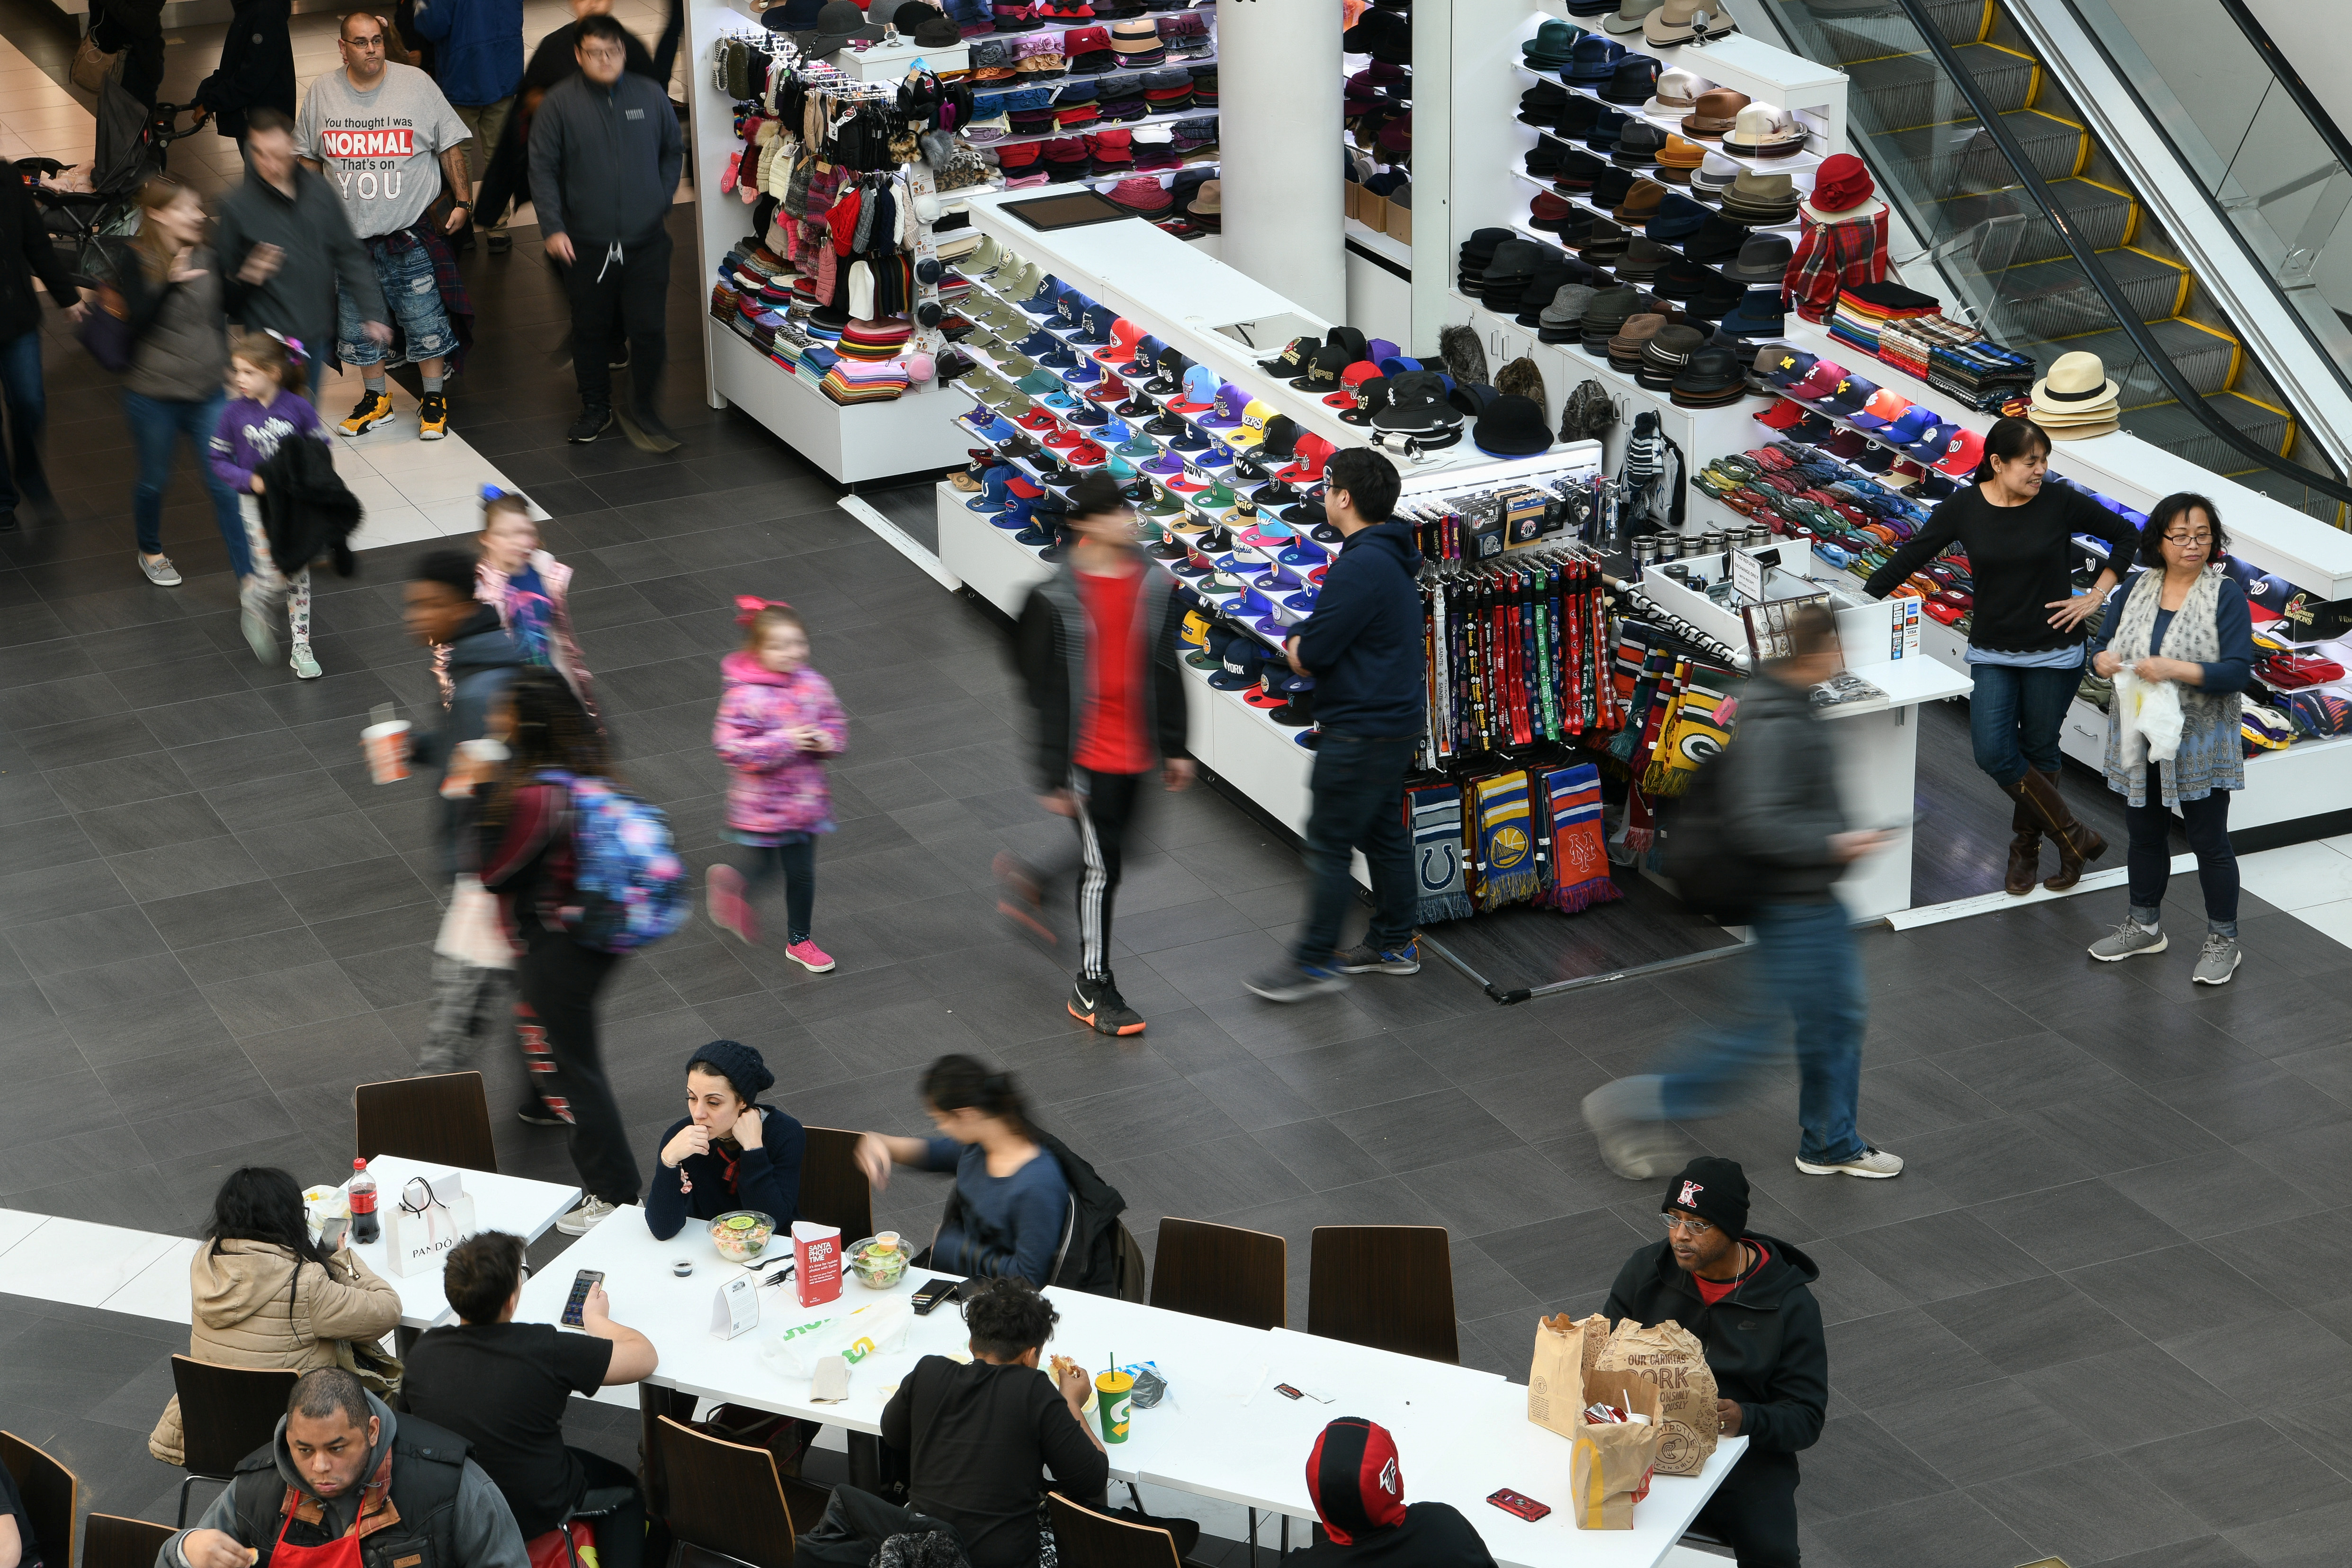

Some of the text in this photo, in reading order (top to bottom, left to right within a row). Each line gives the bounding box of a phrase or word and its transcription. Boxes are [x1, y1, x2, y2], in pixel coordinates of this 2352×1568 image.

[325, 116, 412, 130] You thought I was
[323, 132, 411, 155] NORMAL
[340, 158, 395, 170] That's on
[336, 171, 402, 200] YOU
[1474, 519, 1482, 528] NF
[1735, 562, 1750, 575] EXCHANGE
[1743, 557, 1755, 568] REFUND
[1745, 577, 1754, 585] RECEIPT
[1677, 1180, 1704, 1208] K
[808, 1242, 832, 1252] SANTA
[809, 1247, 832, 1257] PHOTO
[809, 1254, 825, 1263] TIME
[1628, 1354, 1687, 1366] OUR CARNITAS
[1675, 1455, 1694, 1470] GRILL
